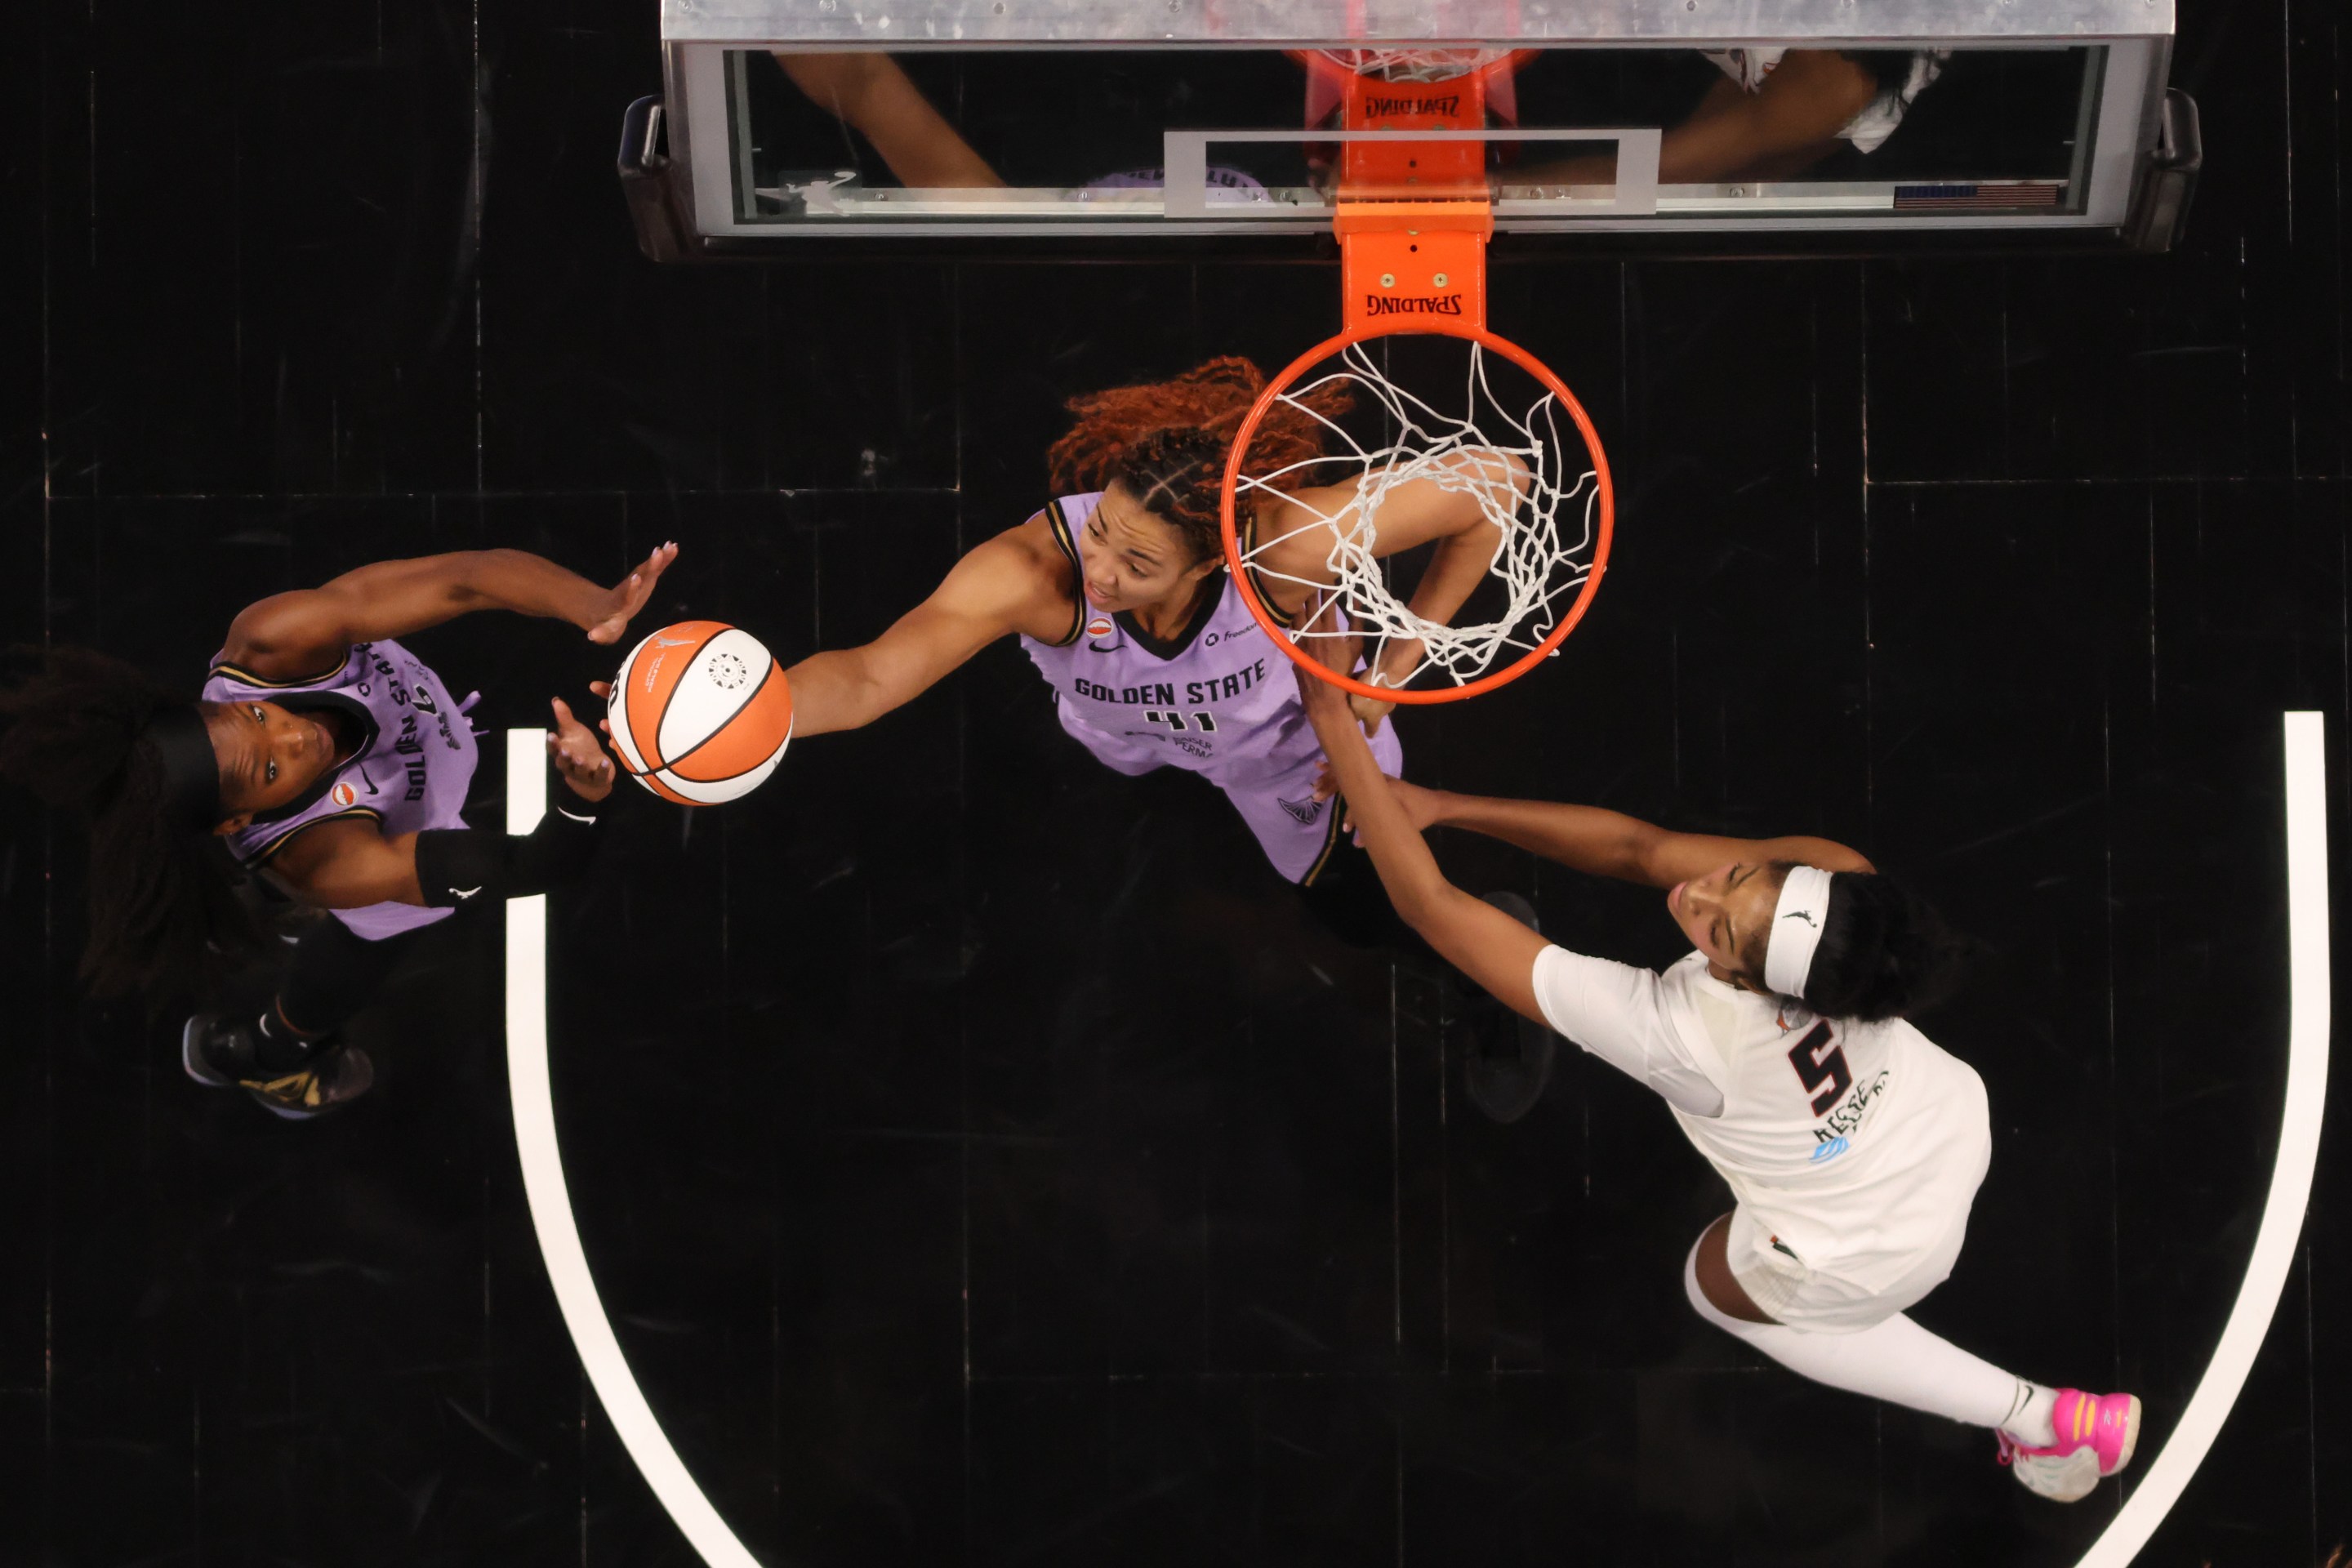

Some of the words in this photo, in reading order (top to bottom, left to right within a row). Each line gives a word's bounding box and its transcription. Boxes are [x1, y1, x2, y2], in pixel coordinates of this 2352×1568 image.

[1366, 293, 1462, 317] SPALDING
[1074, 677, 1176, 706] GOLDEN
[1187, 657, 1266, 705] STATE
[1143, 709, 1218, 733] 41
[395, 715, 425, 801] GOLDEN
[1787, 1018, 1854, 1118] 5
